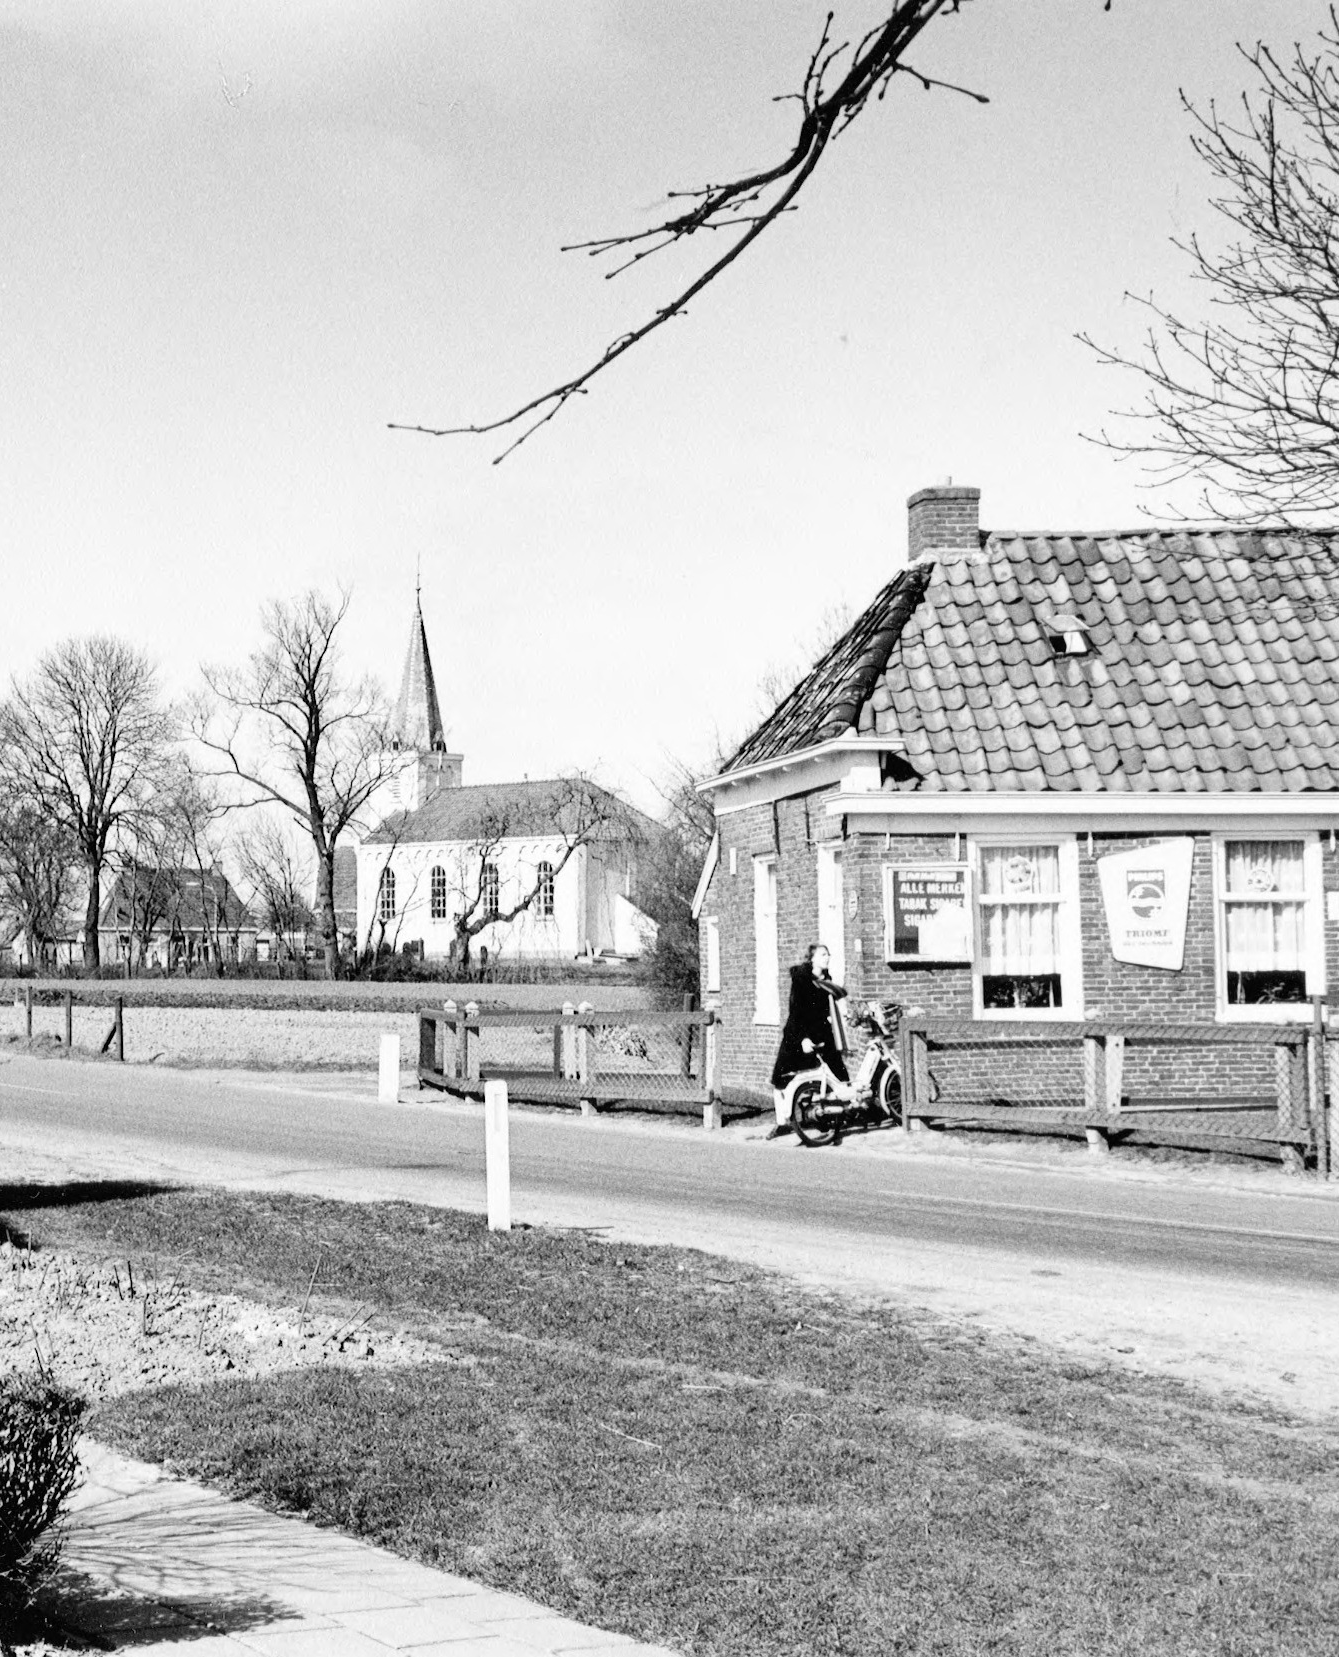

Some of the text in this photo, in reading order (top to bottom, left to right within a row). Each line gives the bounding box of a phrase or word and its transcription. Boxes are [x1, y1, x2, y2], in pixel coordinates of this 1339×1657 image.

[1128, 872, 1164, 882] PHILIPS
[900, 882, 925, 894] ALLE
[899, 898, 965, 911] TABAK SIGARE
